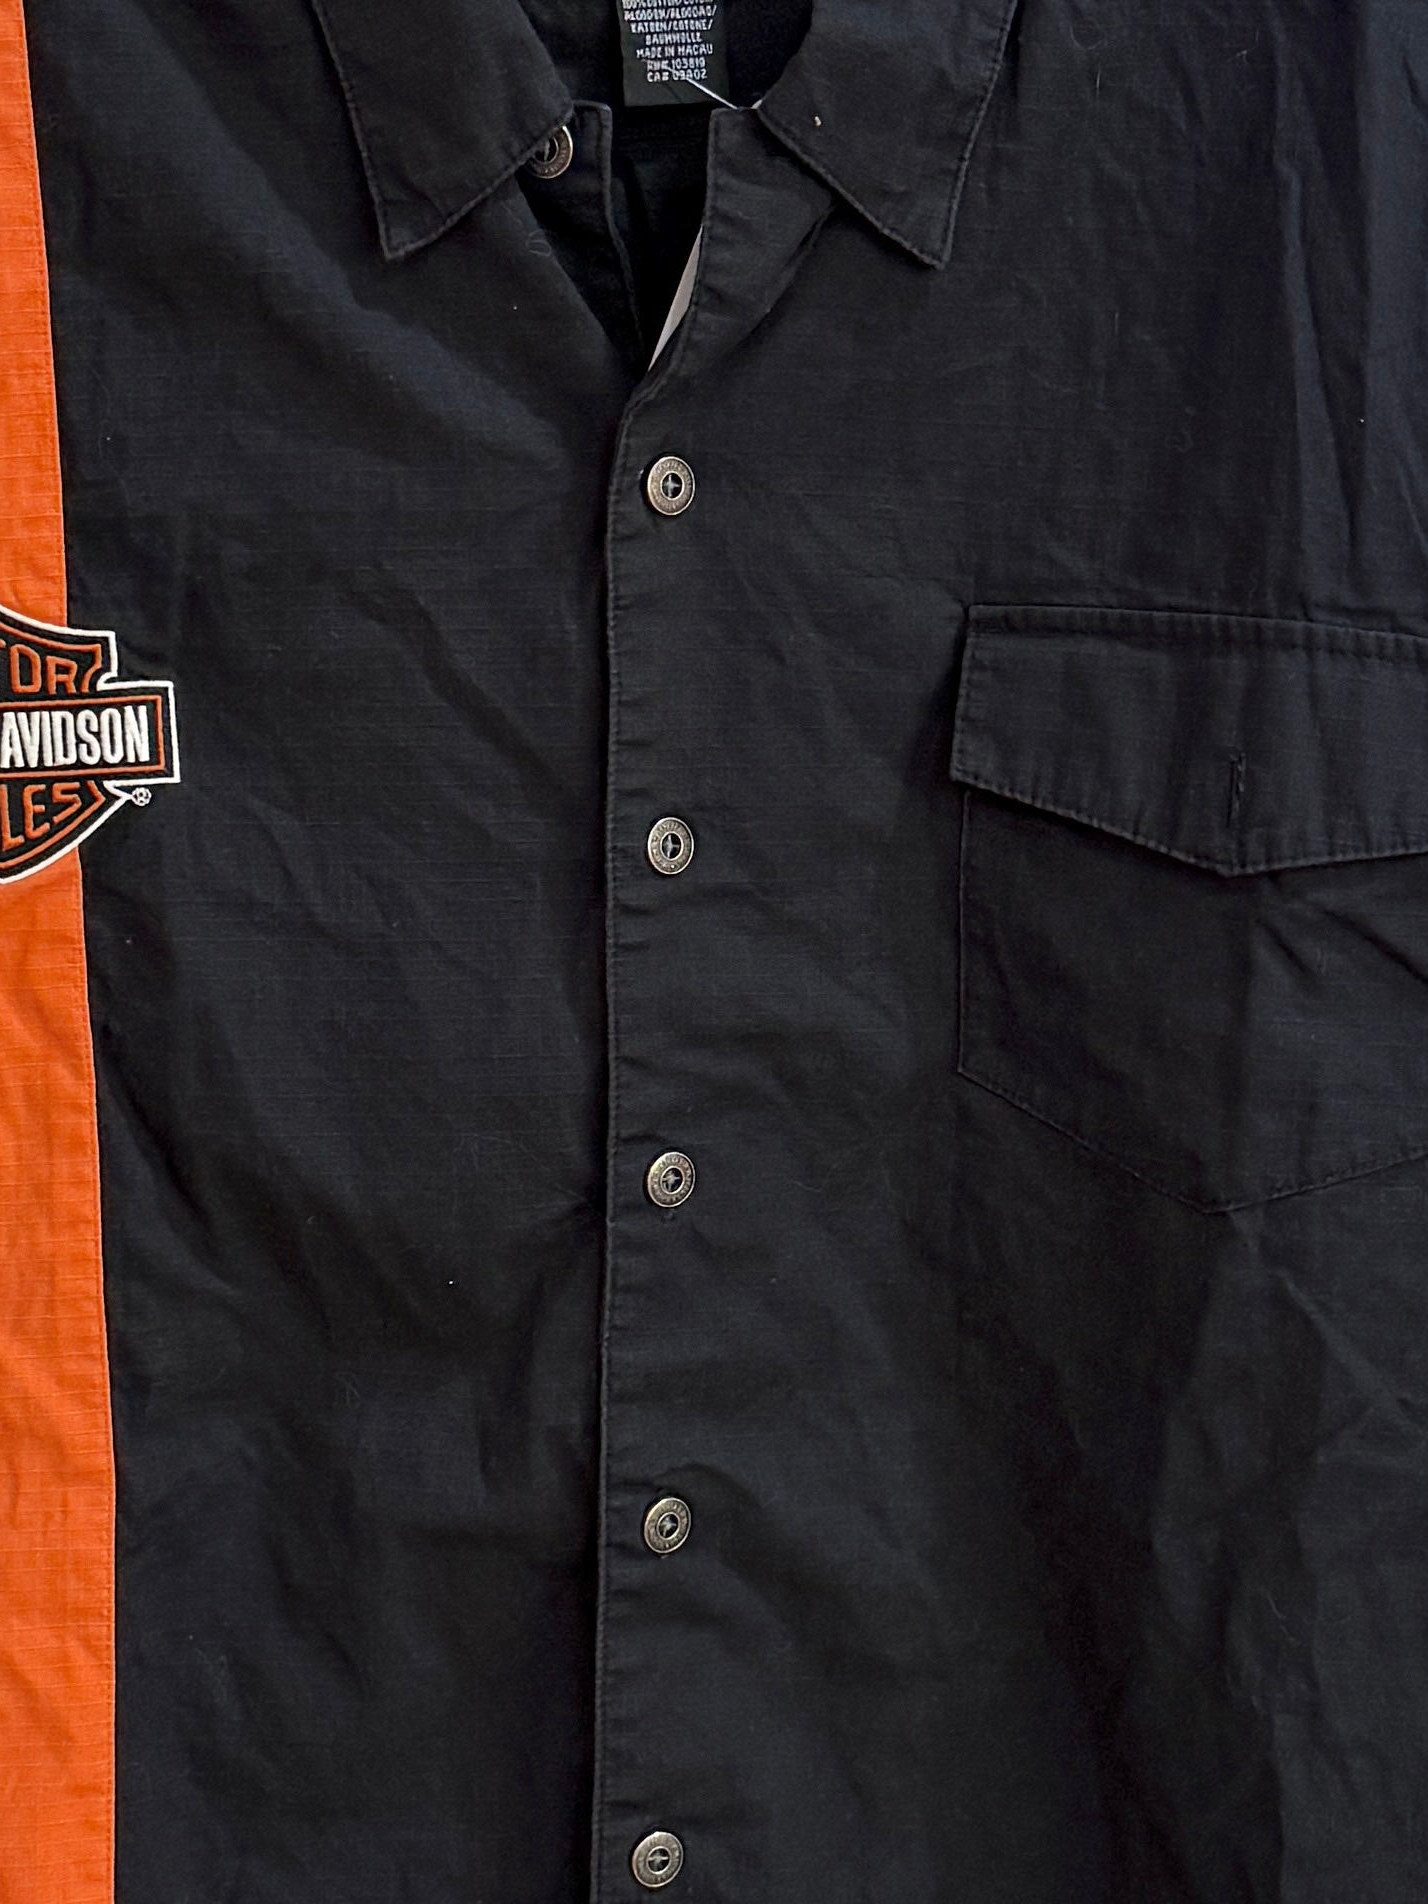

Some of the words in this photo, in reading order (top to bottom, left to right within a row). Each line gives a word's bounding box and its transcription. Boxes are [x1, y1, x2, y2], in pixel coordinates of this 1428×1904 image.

[635, 46, 663, 59] MADE
[664, 45, 675, 57] IN
[677, 43, 714, 56] MACAU
